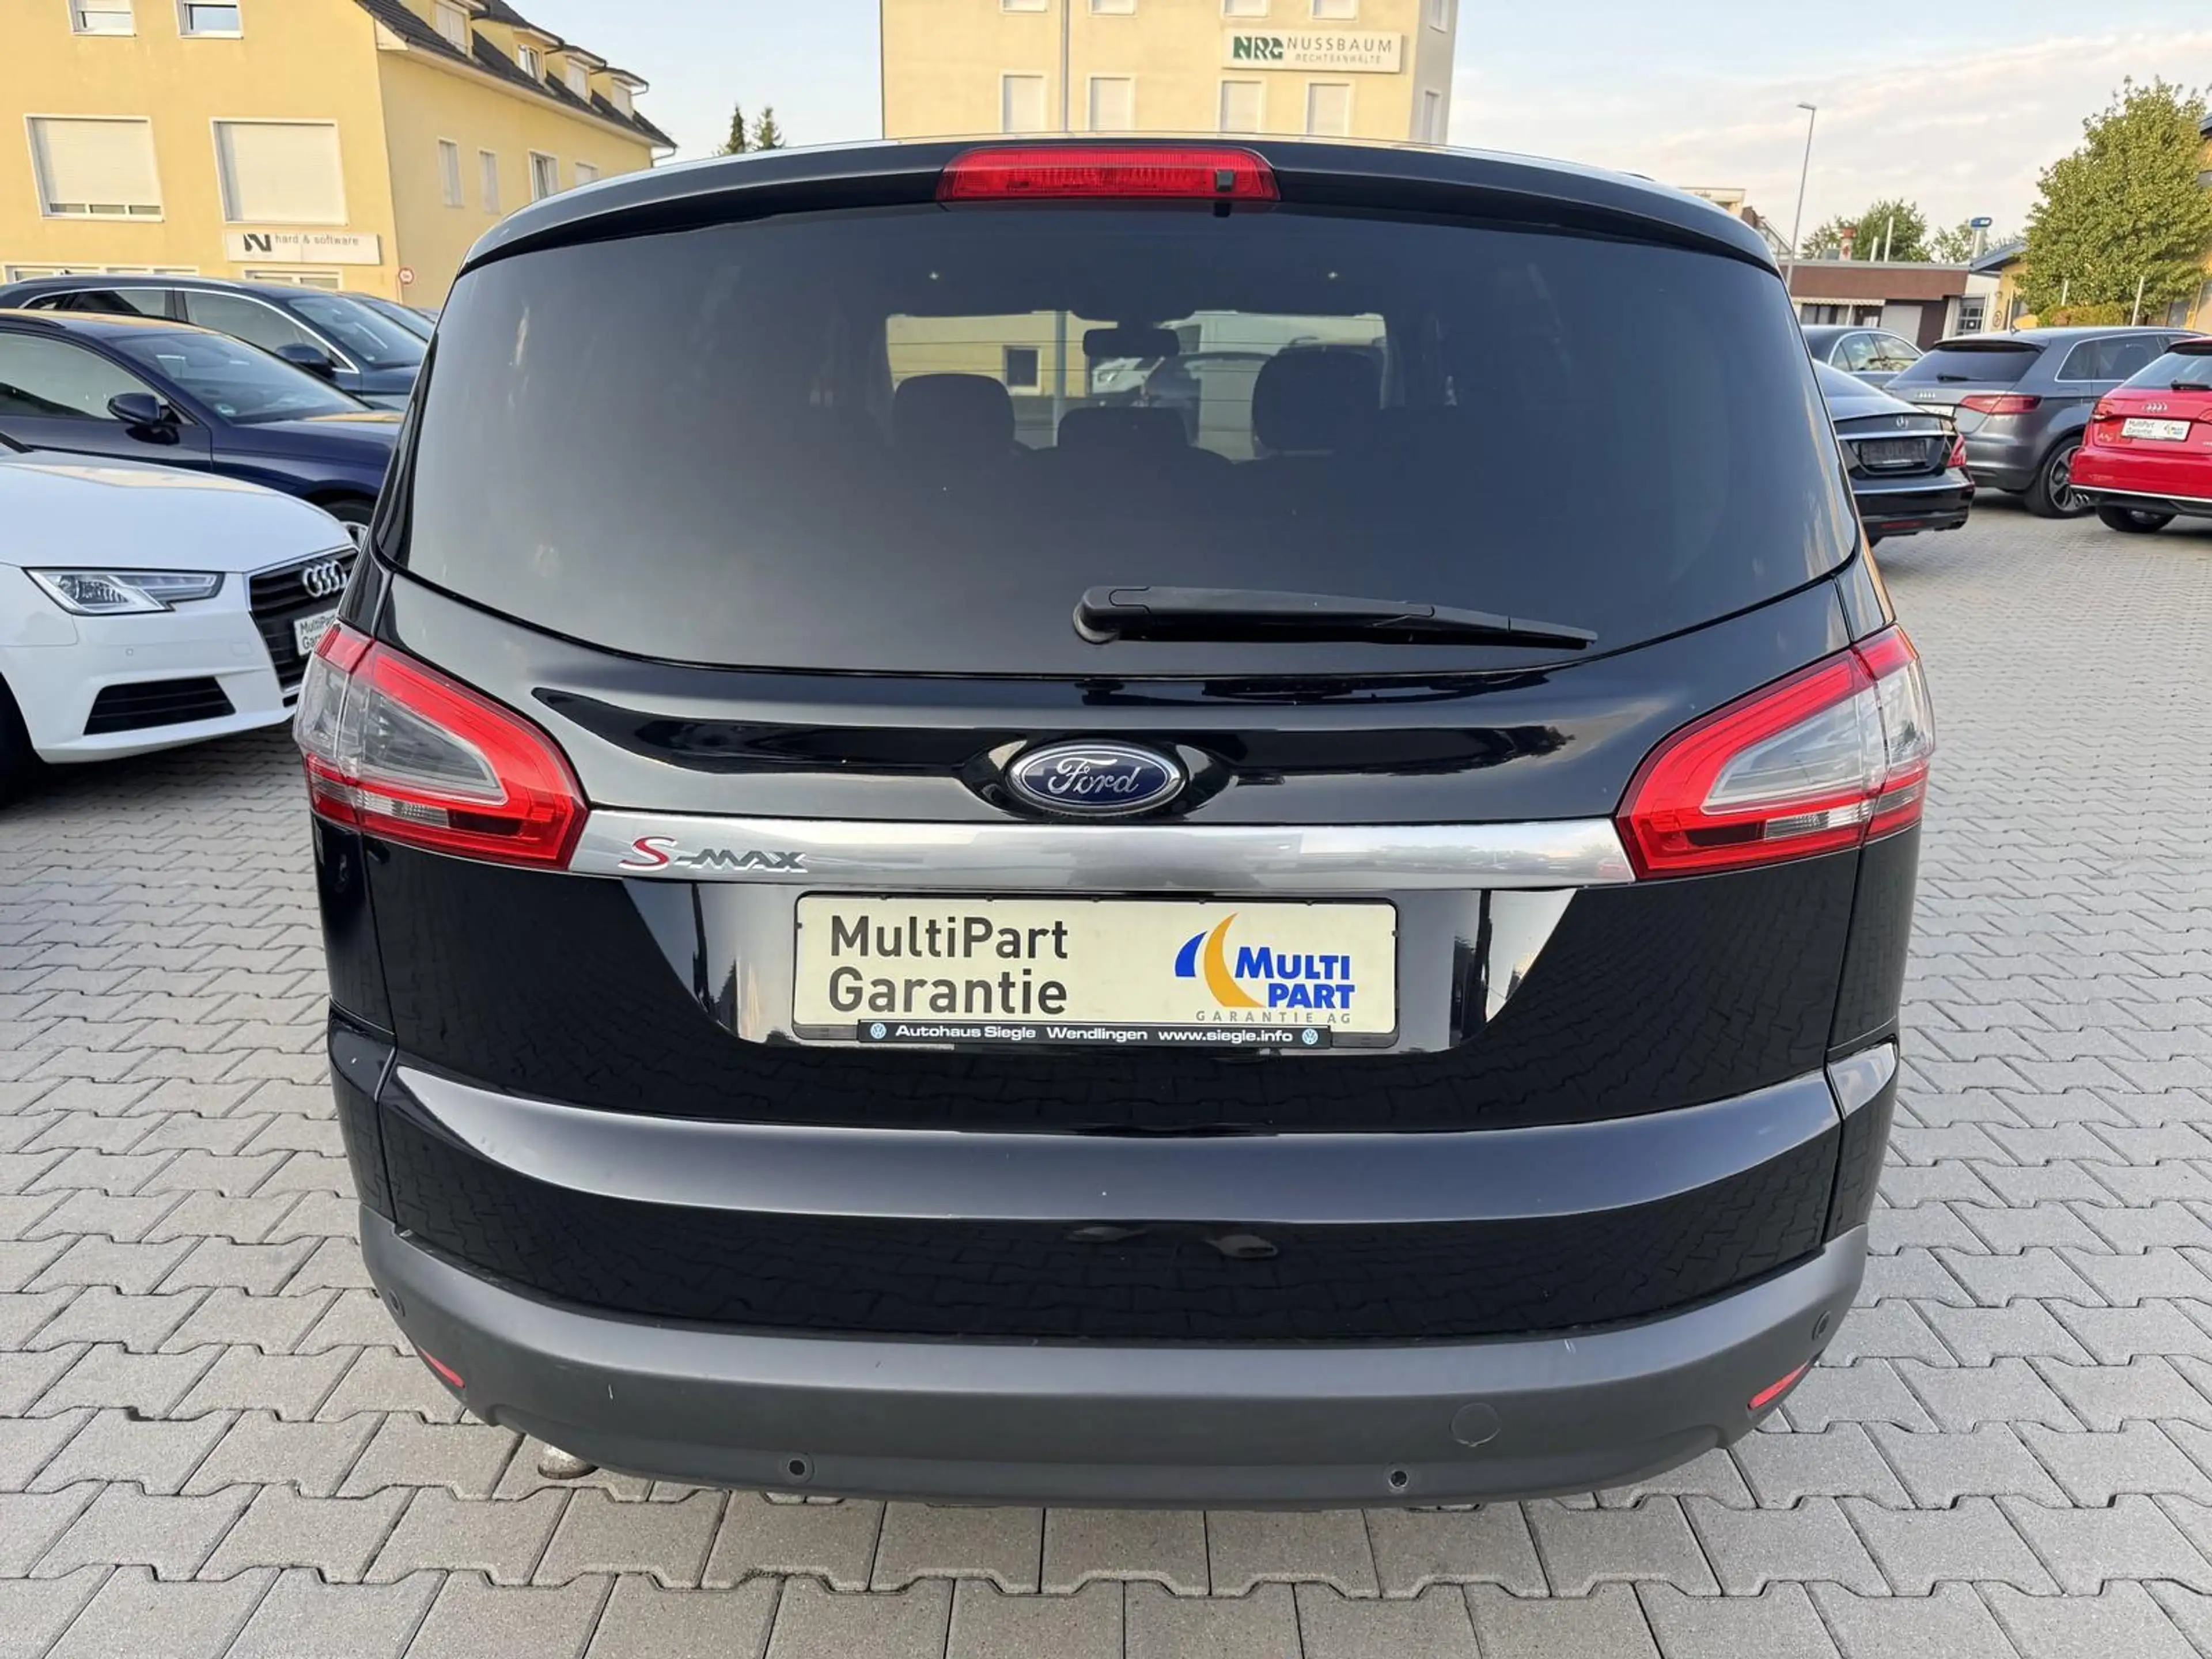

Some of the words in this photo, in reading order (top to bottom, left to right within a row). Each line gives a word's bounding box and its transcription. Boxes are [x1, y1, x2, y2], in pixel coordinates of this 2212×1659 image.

[1233, 36, 1284, 60] NRG
[1287, 36, 1392, 53] NUSSBAUM
[275, 232, 298, 244] hard
[303, 233, 310, 244] &
[314, 233, 359, 246] software
[1047, 757, 1142, 795] Ford
[618, 835, 808, 873] S-MAX
[830, 915, 1069, 960] MultiPart
[828, 965, 1067, 1015] Garantie
[1267, 983, 1355, 1009] PART
[1195, 1010, 1313, 1024] GARANTIE
[1327, 1012, 1351, 1024] AG
[895, 1024, 982, 1037] Autohaus
[984, 1025, 1036, 1041] Siegle
[1046, 1027, 1149, 1043] Wendlingen
[1157, 1029, 1294, 1045] www.siegle.info
